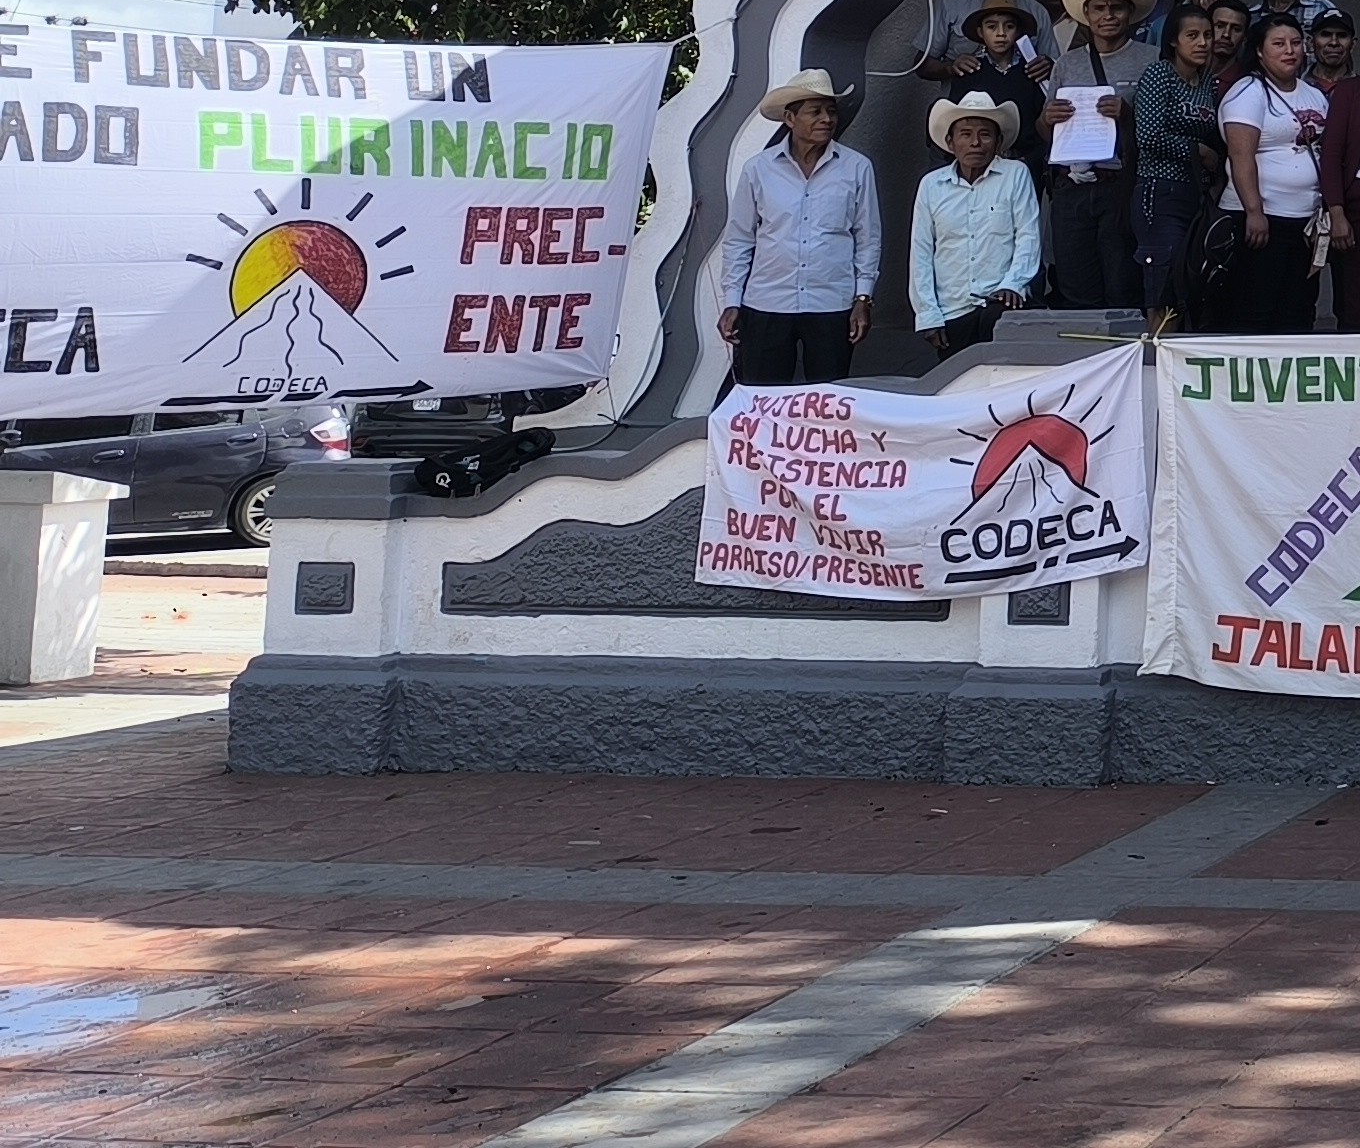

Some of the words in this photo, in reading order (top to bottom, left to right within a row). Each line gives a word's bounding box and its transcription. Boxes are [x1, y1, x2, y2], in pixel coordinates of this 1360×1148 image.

[71, 30, 366, 101] FUNDAR
[403, 49, 491, 103] UN
[460, 207, 626, 265] PREC-
[443, 293, 591, 354] ENTE
[238, 376, 328, 394] CODECA
[749, 392, 856, 420] MUJERES
[771, 422, 857, 454] LUCHA
[871, 431, 887, 452] Y
[728, 439, 907, 488] REISTENCIA
[727, 508, 796, 543] BUEN
[814, 494, 846, 521] EL
[941, 500, 1122, 563] CODECA
[700, 542, 924, 589] PARAISO/PRESENTE
